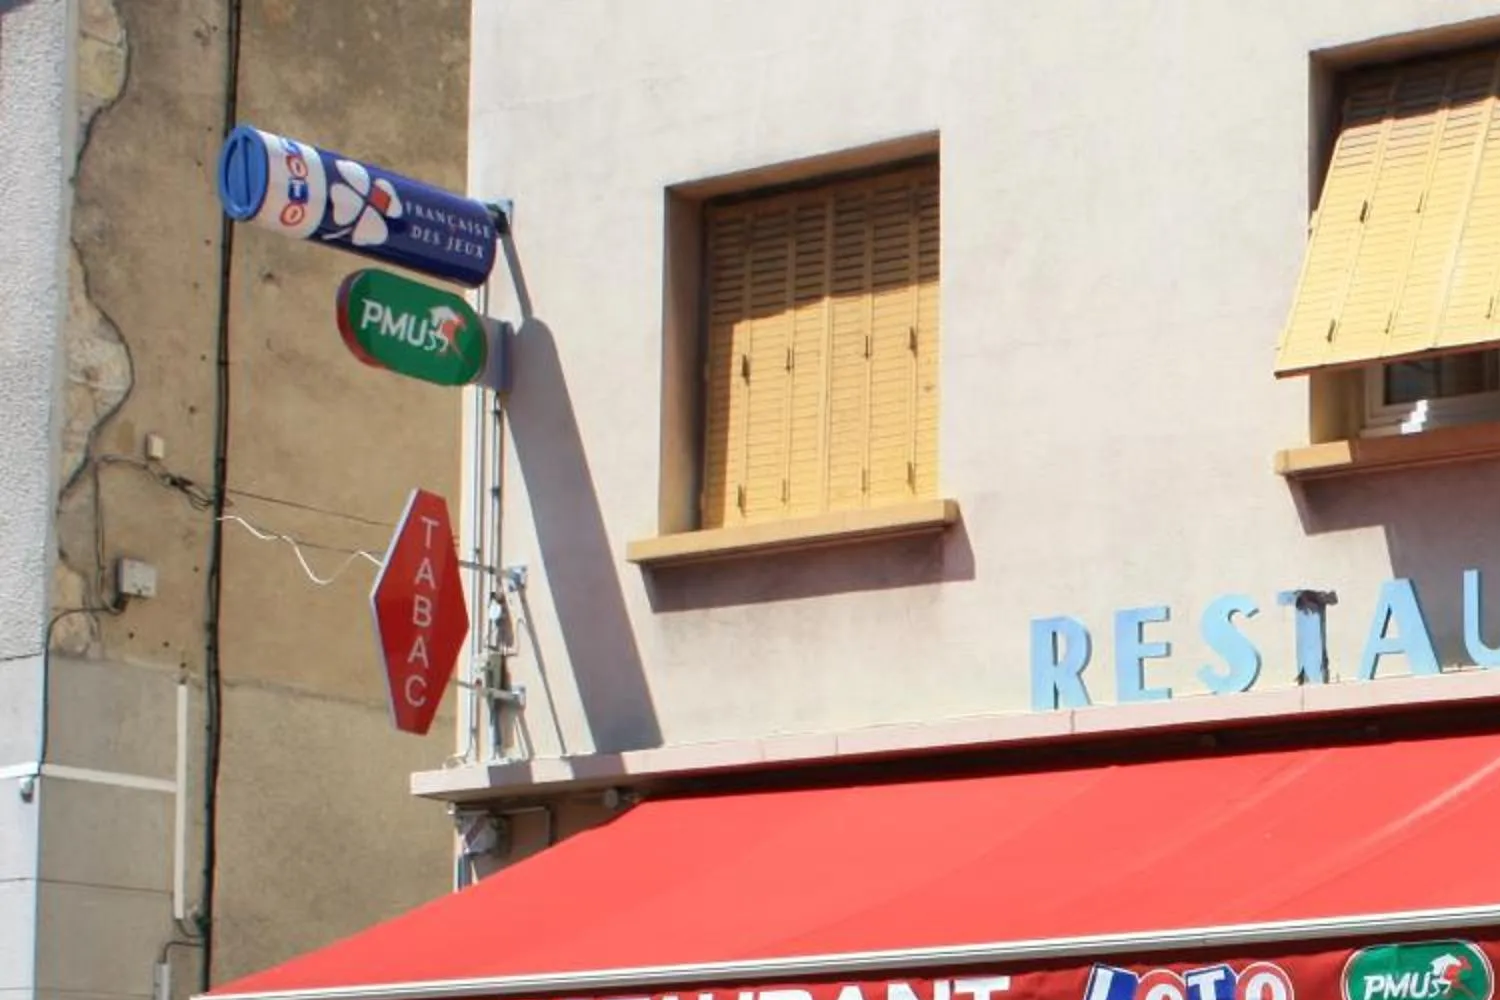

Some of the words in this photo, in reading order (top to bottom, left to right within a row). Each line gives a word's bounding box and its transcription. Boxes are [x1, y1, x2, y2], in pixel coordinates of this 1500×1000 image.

[404, 200, 490, 240] FRANÇAISE
[410, 224, 441, 246] DES
[445, 236, 484, 259] JEUX
[360, 298, 428, 347] PMU
[404, 516, 440, 707] TABAC
